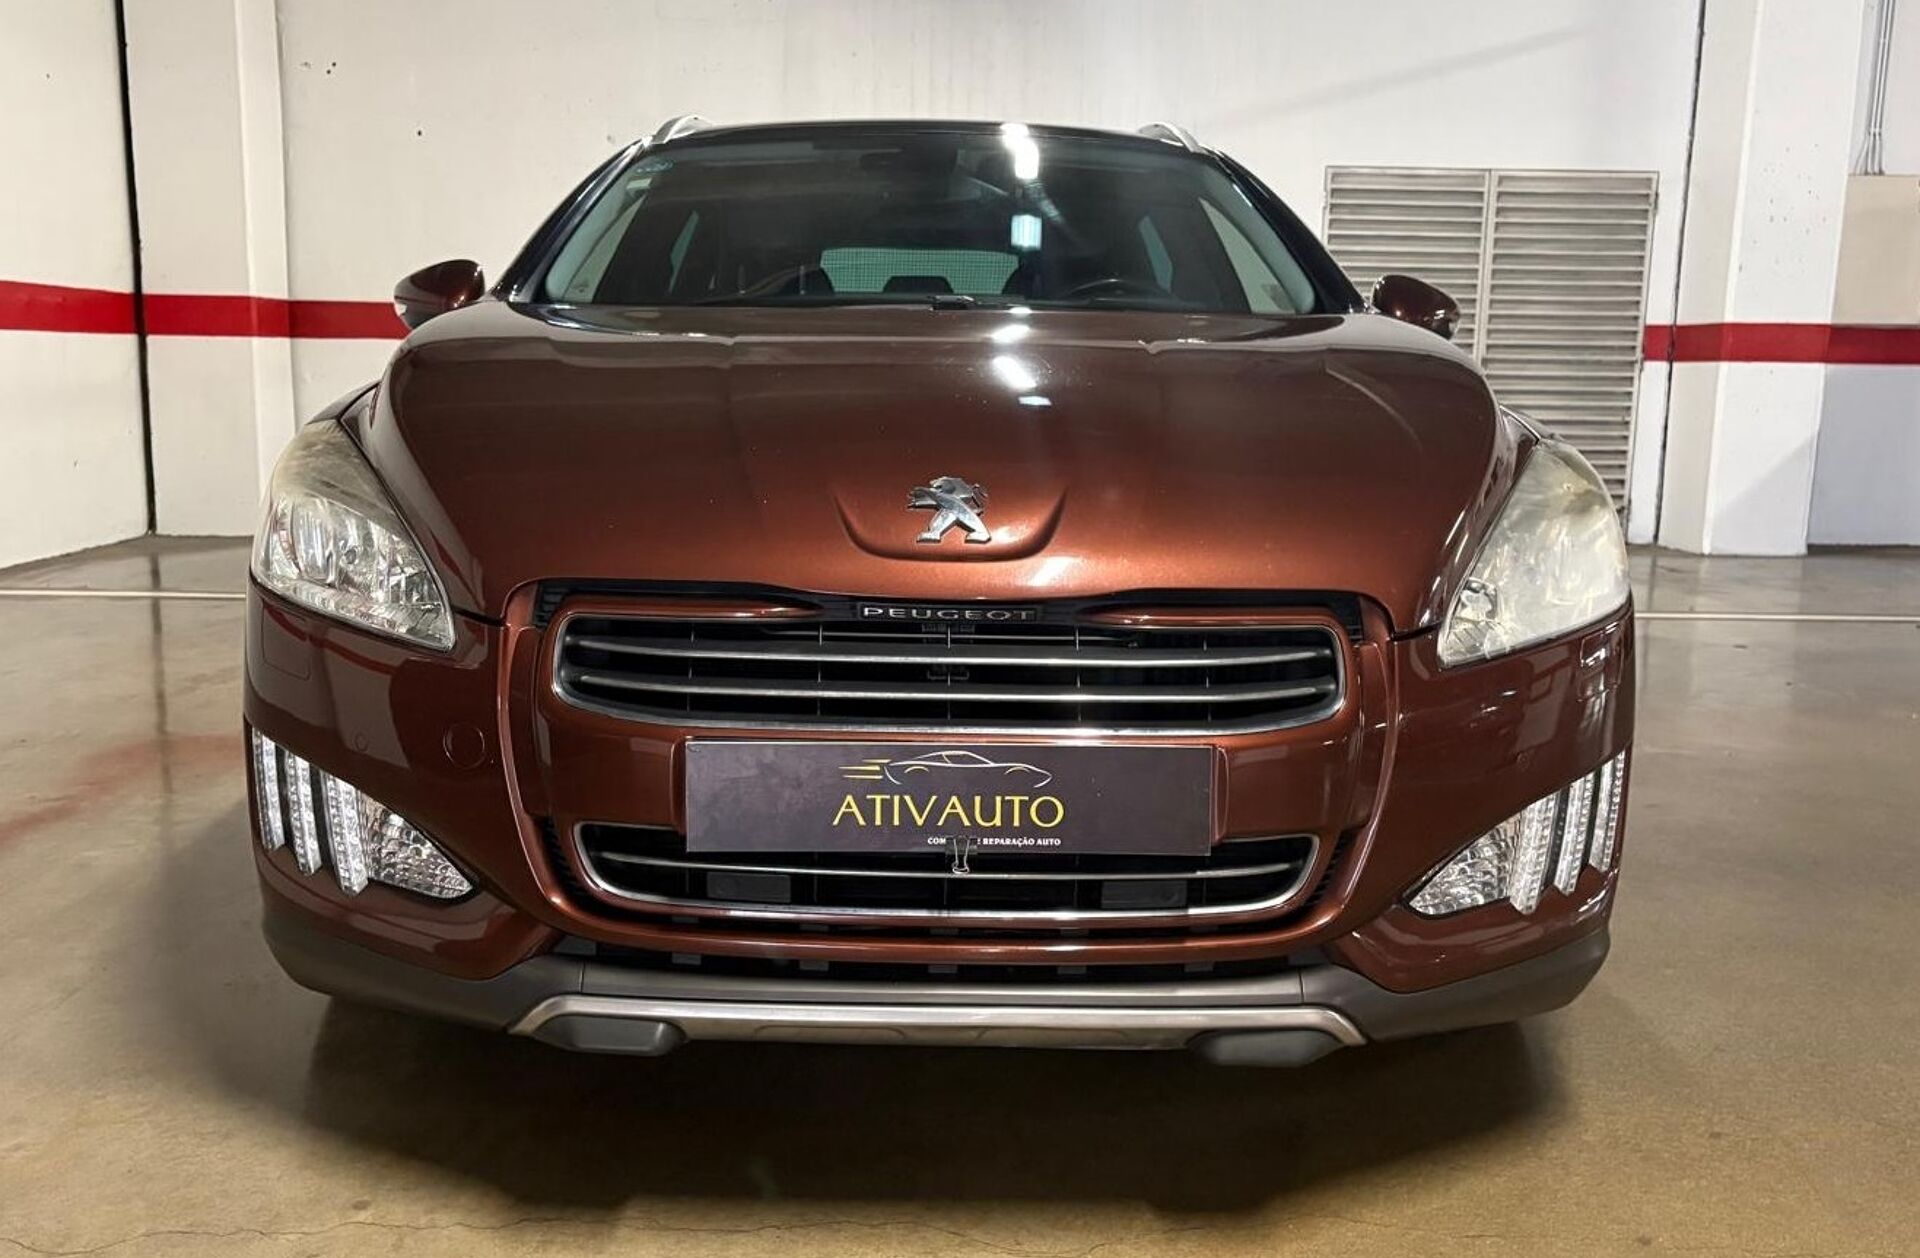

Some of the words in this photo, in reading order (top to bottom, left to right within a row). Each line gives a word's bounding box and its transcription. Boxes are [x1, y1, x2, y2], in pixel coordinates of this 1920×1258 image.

[863, 606, 1036, 621] PEUGEOT
[832, 794, 1065, 828] ATIVAUTO
[982, 836, 1035, 847] REPARAÇÃO
[1036, 838, 1061, 846] AUTO
